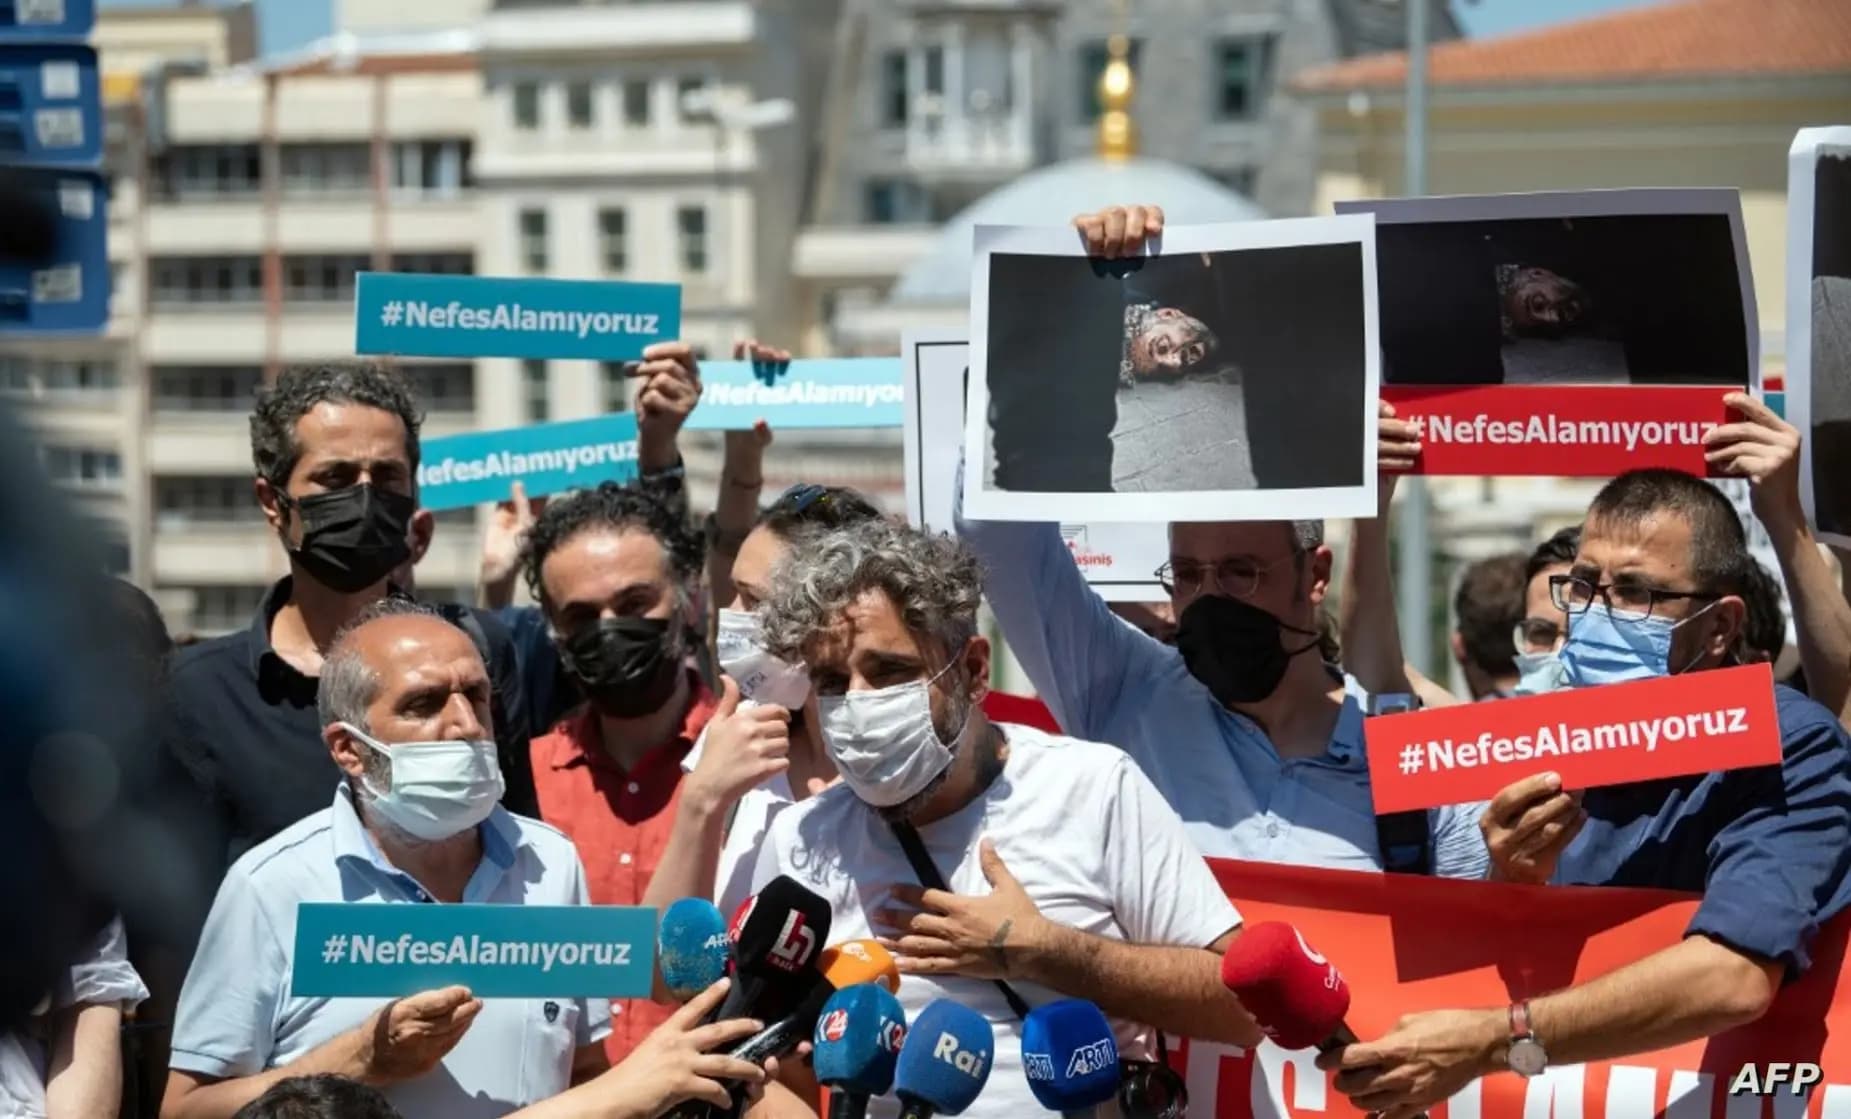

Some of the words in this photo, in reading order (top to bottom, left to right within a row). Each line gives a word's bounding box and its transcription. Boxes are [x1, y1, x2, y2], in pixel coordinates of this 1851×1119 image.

[380, 301, 660, 338] #NefesAlamıyoruz
[1398, 706, 1749, 775] #NefesAlamıyoruz
[321, 934, 632, 972] #NefesAlamıyoruz
[933, 1031, 986, 1079] Rai
